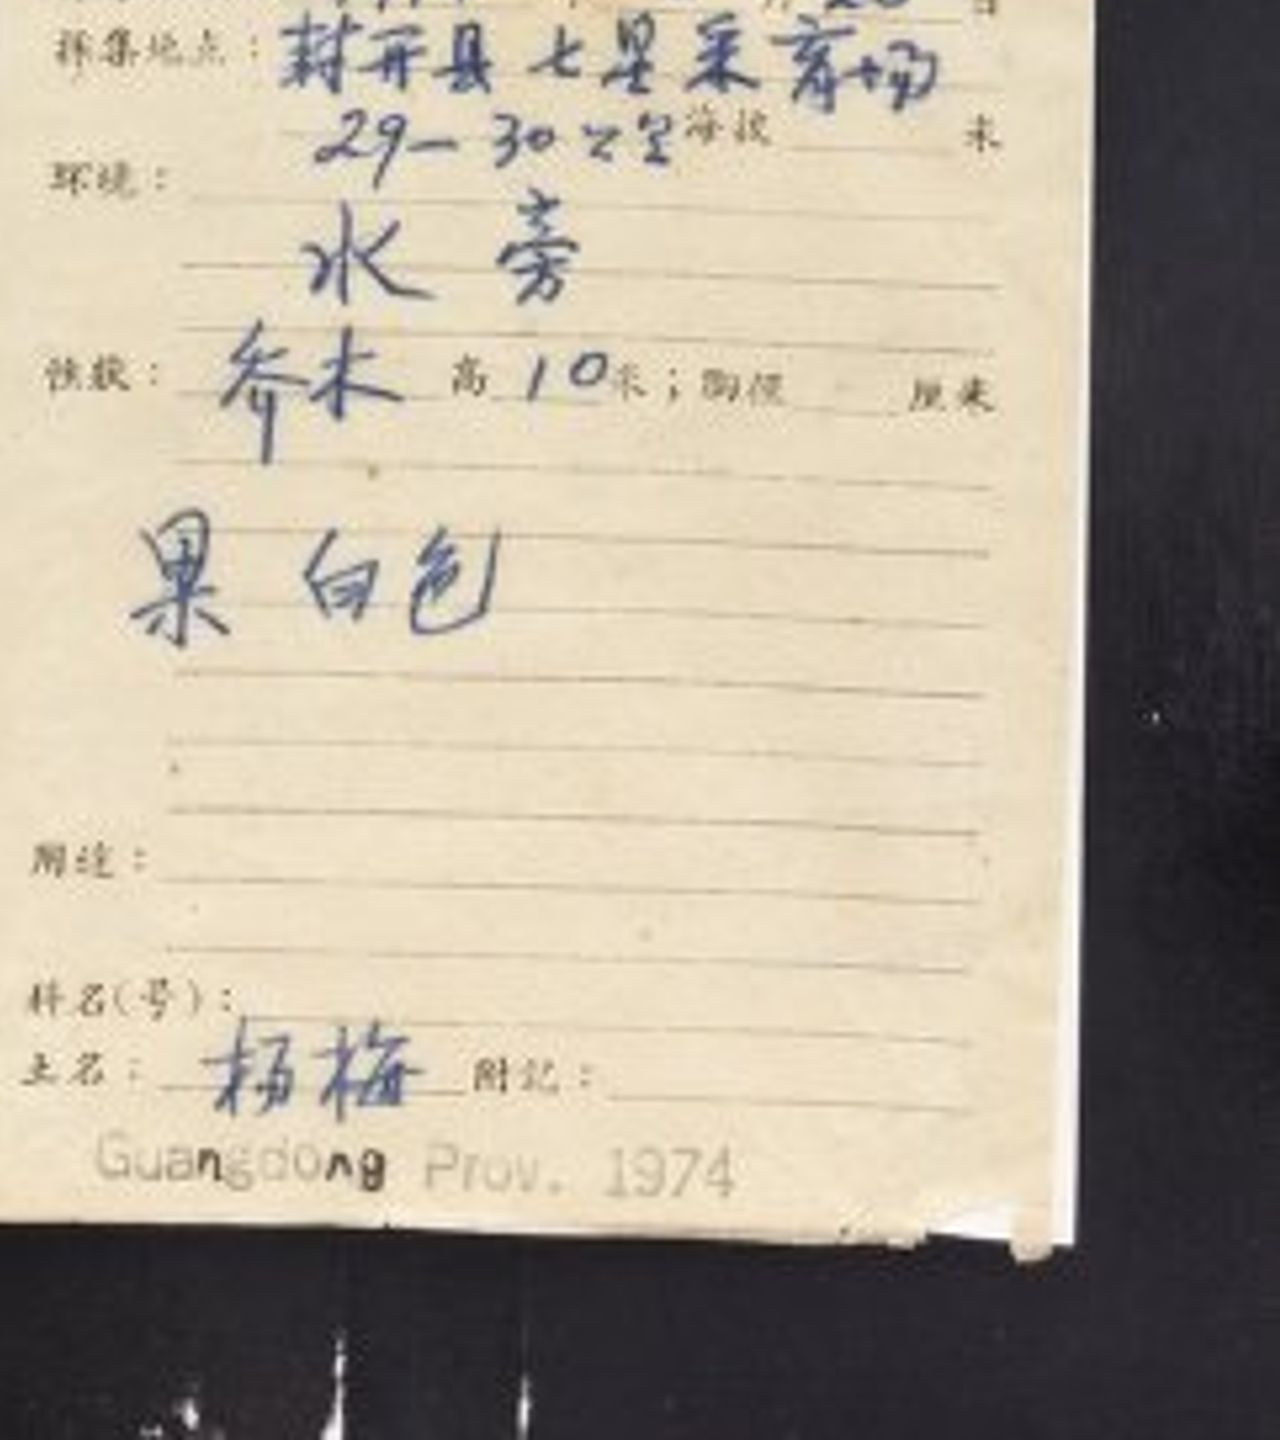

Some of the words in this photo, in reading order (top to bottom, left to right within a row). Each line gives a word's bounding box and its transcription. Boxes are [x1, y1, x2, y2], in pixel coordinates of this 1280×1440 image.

[451, 353, 488, 397] 高
[526, 351, 609, 401] 10
[95, 1132, 386, 1194] Guangdong
[425, 1144, 563, 1196] Prov.
[603, 1146, 738, 1200] 1974
